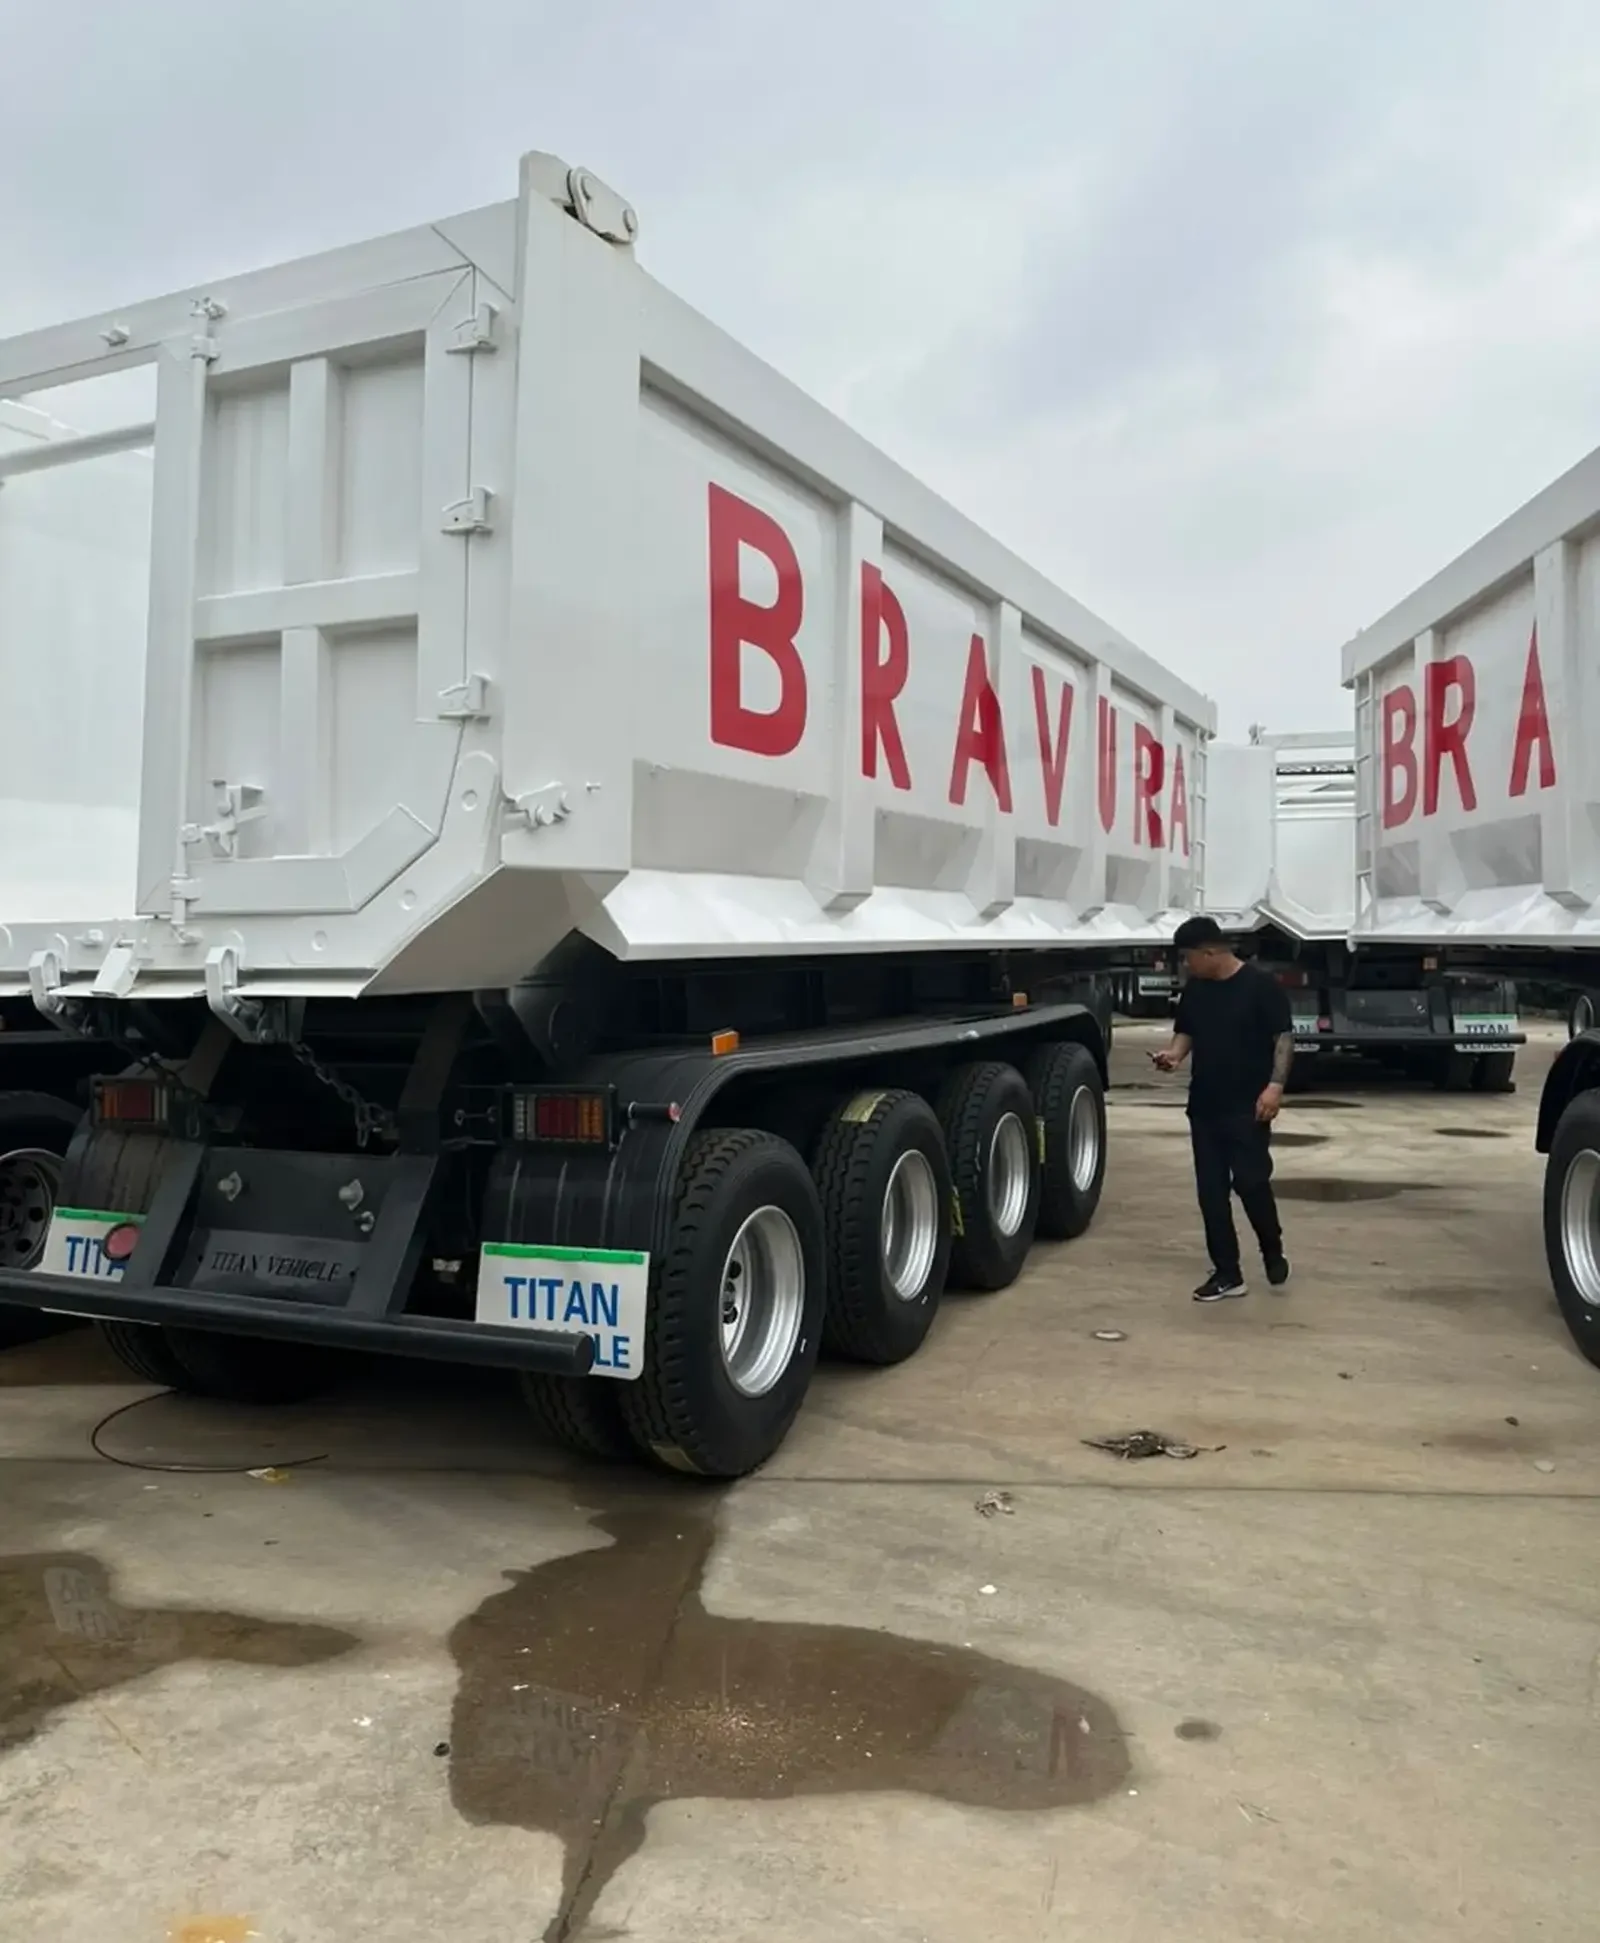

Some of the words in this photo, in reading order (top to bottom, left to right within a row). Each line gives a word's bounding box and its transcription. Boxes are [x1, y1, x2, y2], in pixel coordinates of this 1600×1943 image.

[708, 481, 1189, 857] BRAVURA
[1383, 617, 1556, 829] BRA
[268, 1254, 342, 1281] VEHICLE
[503, 1276, 619, 1327] TITAN
